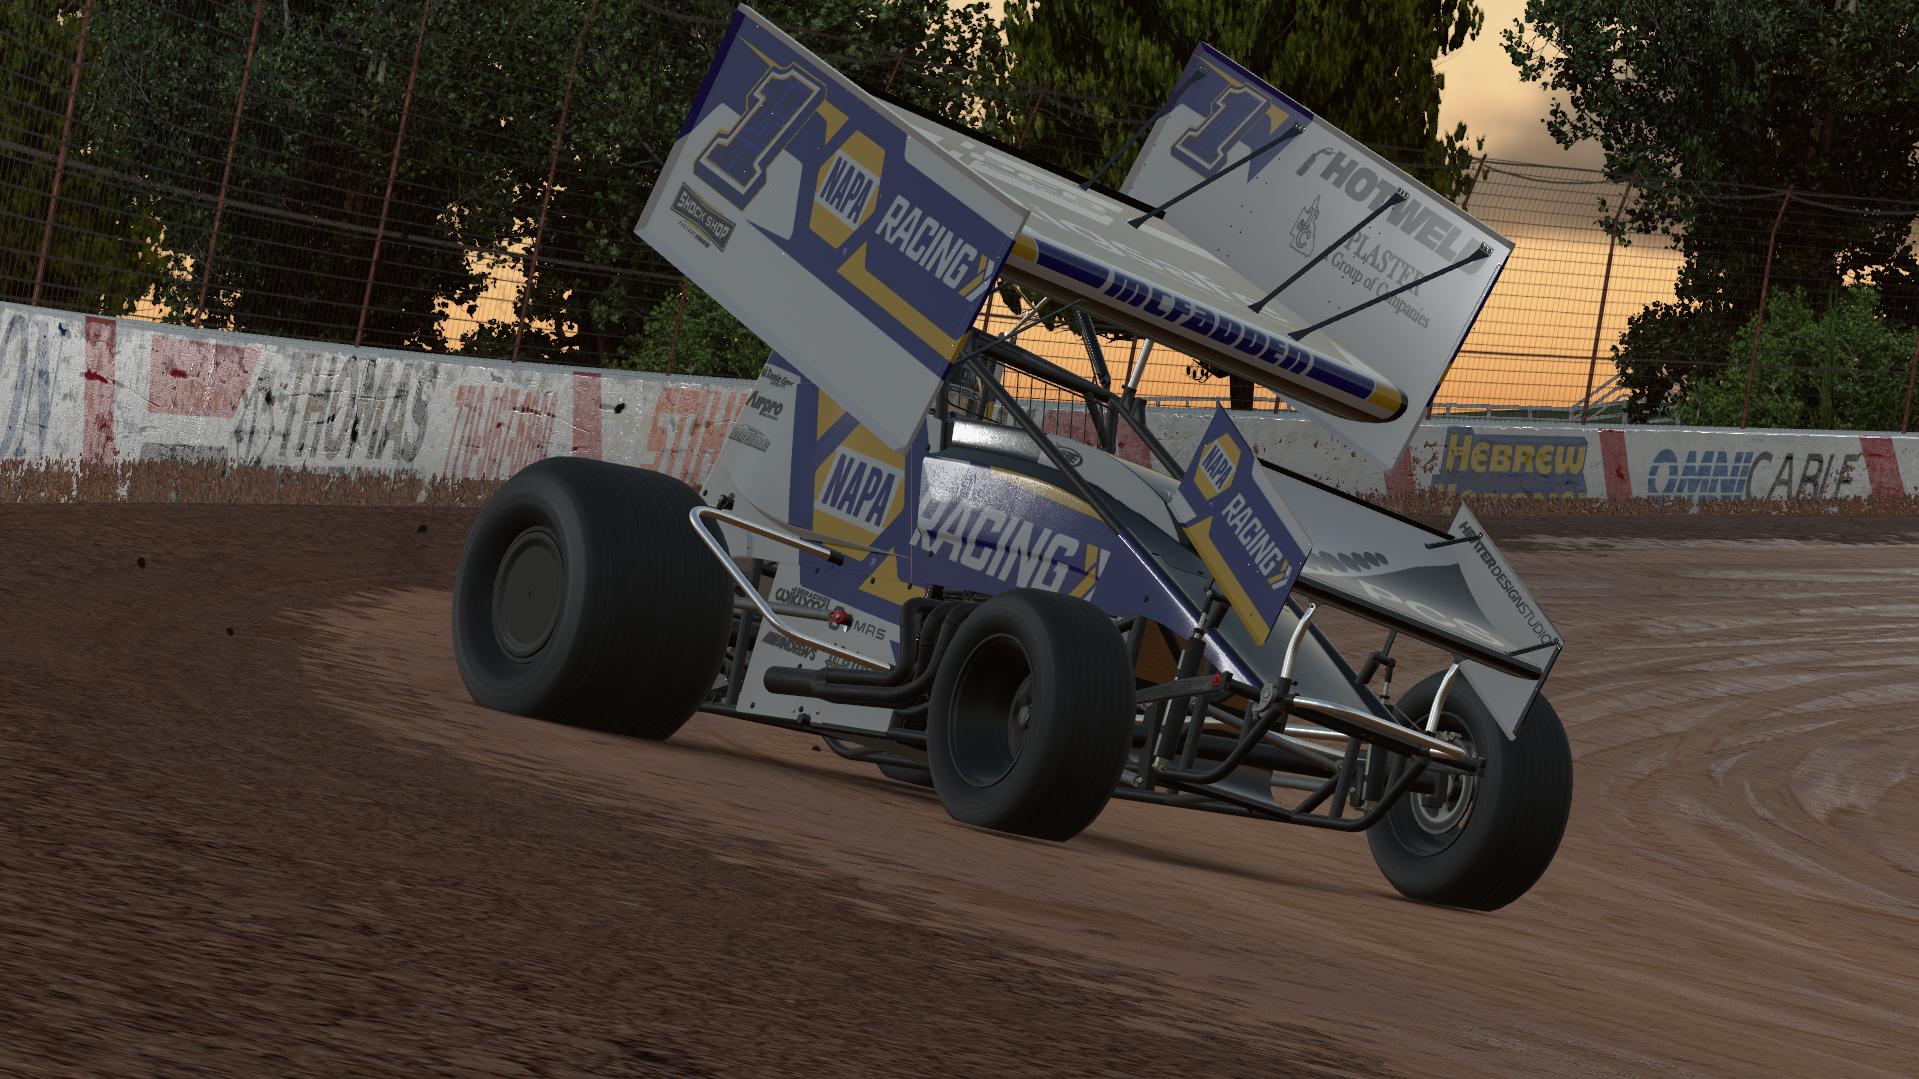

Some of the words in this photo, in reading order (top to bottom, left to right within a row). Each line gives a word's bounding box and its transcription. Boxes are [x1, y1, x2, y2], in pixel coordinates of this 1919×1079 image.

[695, 64, 826, 209] 1
[1172, 84, 1273, 178] 1
[677, 191, 706, 222] SHOCK
[705, 215, 730, 239] SHOP
[820, 156, 875, 229] NAPA
[875, 195, 978, 289] RACING
[1331, 252, 1361, 284] Group
[1362, 275, 1378, 292] of
[1376, 282, 1431, 329] Cmpanies
[822, 456, 896, 528] NAPA
[910, 499, 1079, 591] RACING
[1201, 443, 1232, 490] NAPA
[1221, 493, 1282, 575] RACING
[854, 619, 887, 640] MRS
